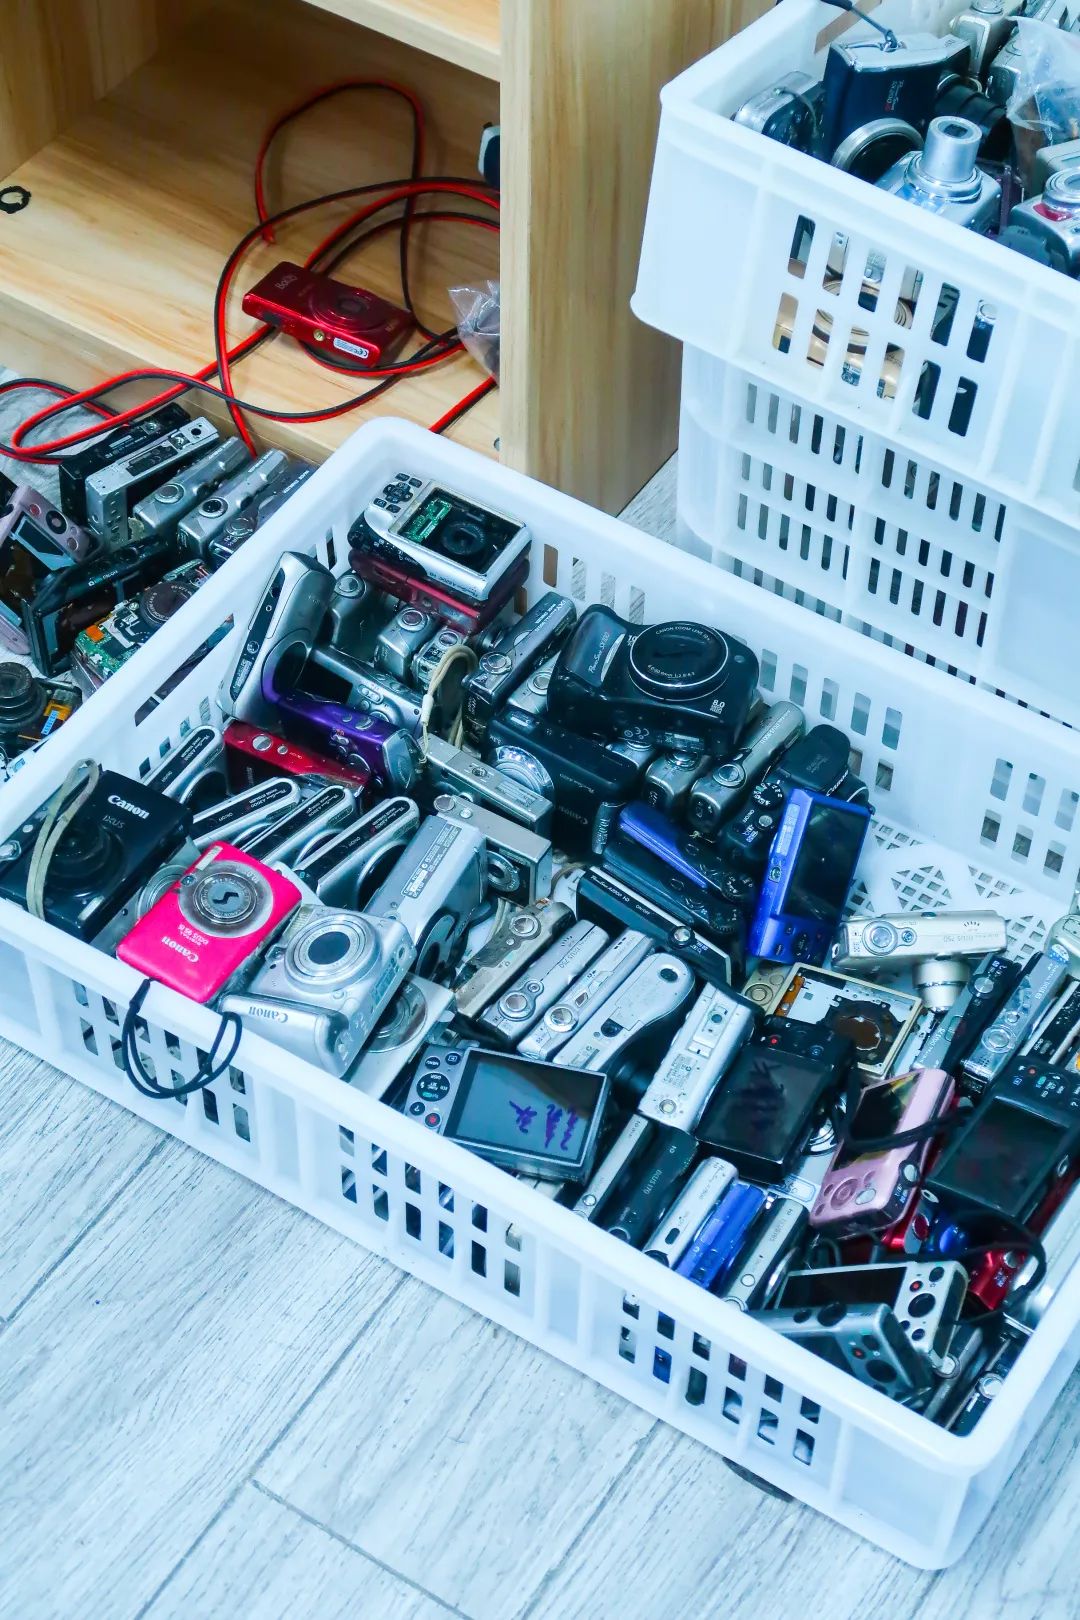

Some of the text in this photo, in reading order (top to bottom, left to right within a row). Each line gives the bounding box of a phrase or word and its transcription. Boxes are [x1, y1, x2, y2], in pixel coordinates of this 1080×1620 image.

[655, 626, 675, 635] CANON
[712, 699, 726, 708] 8.0
[106, 794, 151, 820] Canon
[102, 814, 127, 829] IXUS
[634, 903, 651, 916] ON/OFF
[161, 936, 200, 963] Canon
[248, 1006, 290, 1024] Canon
[649, 1168, 664, 1186] IXUS
